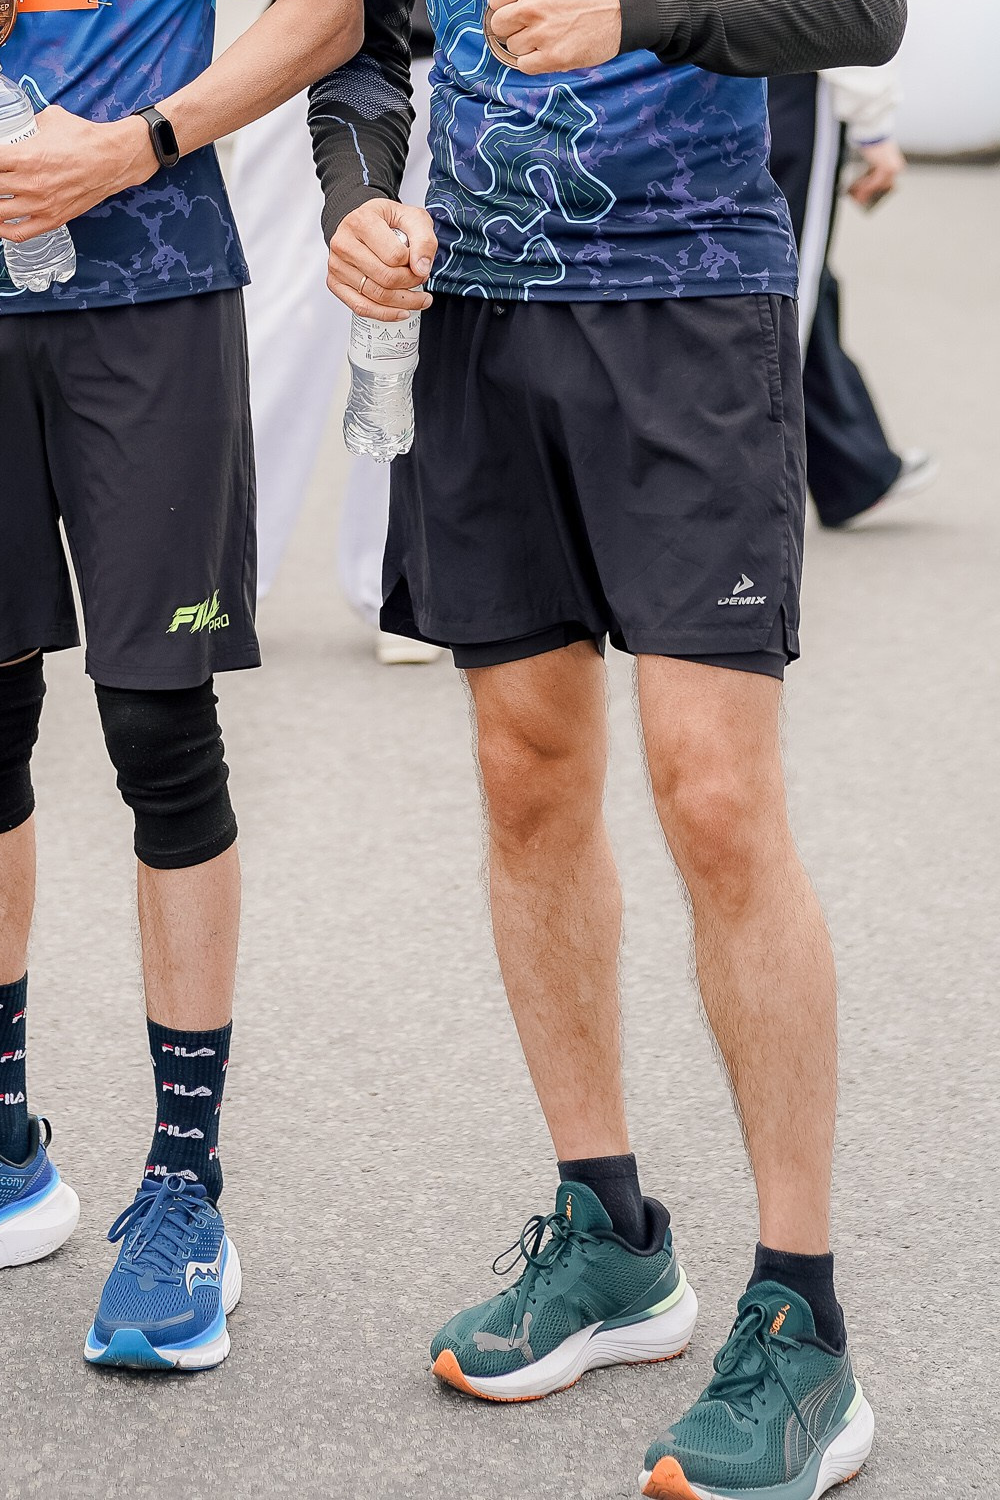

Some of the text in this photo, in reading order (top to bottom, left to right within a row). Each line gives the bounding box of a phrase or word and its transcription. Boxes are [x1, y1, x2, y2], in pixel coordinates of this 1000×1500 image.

[717, 595, 767, 606] DEMIX
[208, 613, 230, 634] PRO
[161, 1043, 216, 1058] FILA
[162, 1081, 213, 1098] FILA
[157, 1121, 205, 1140] FILA
[144, 1164, 199, 1183] FILA
